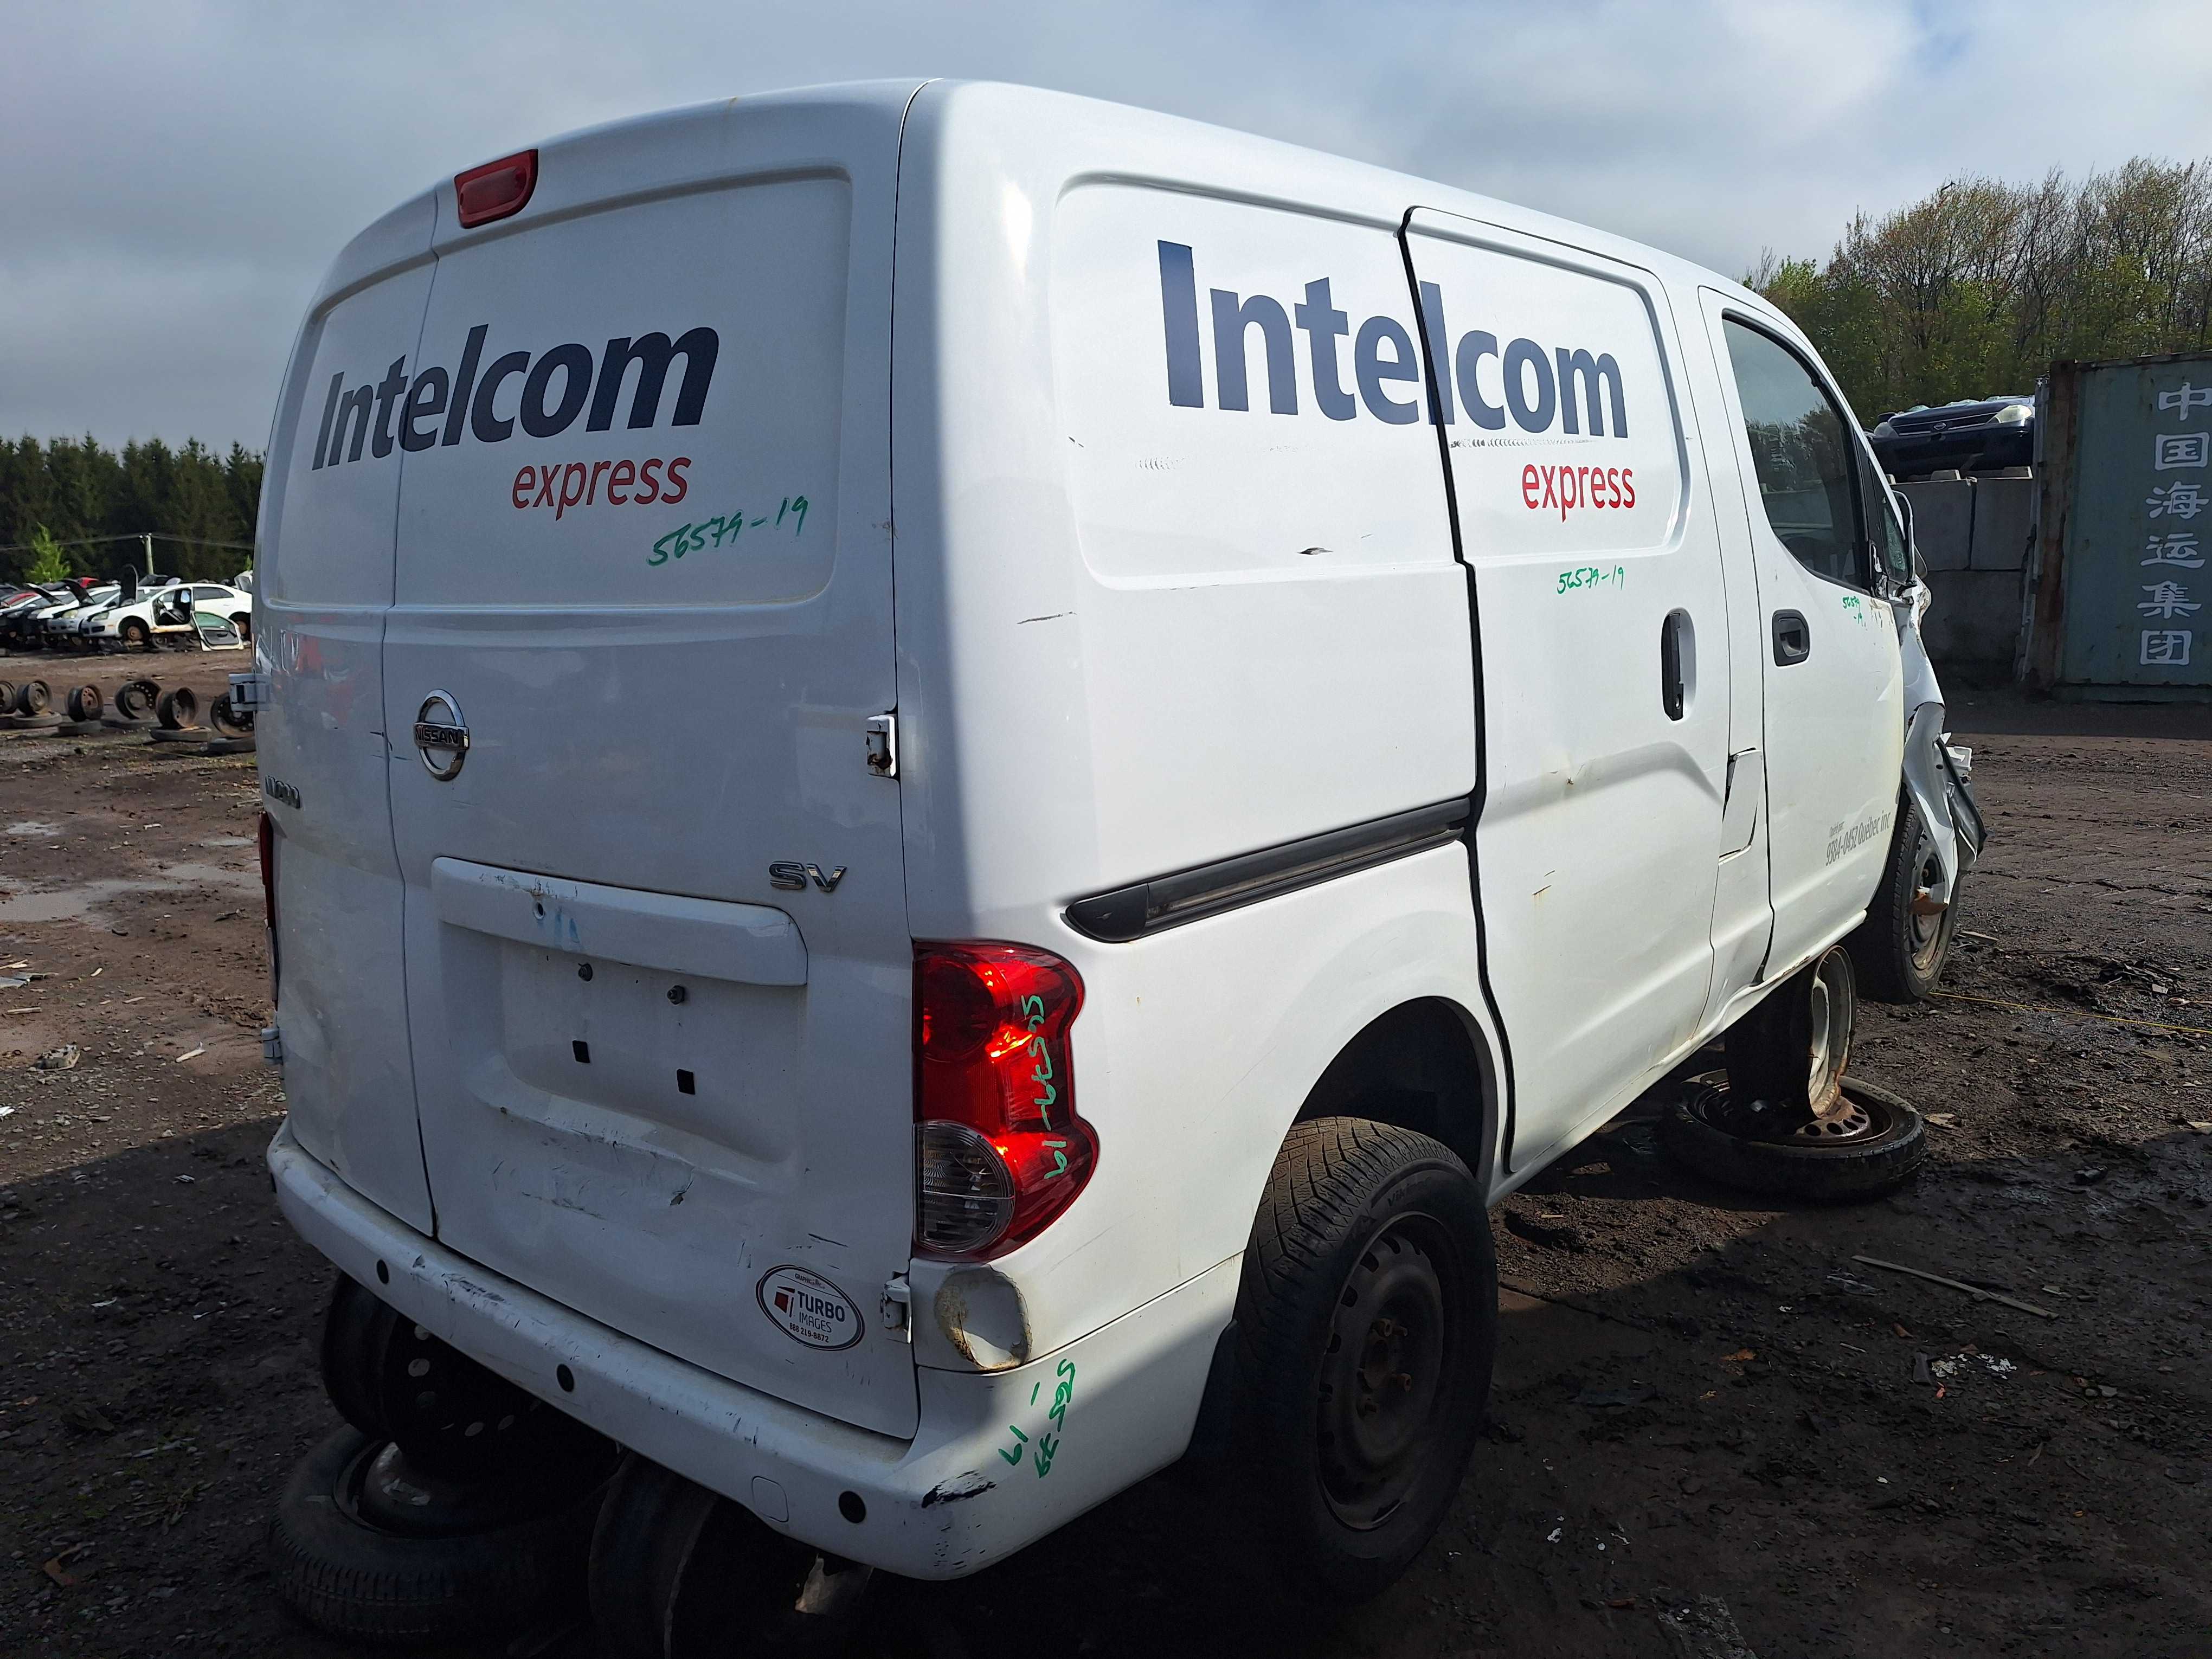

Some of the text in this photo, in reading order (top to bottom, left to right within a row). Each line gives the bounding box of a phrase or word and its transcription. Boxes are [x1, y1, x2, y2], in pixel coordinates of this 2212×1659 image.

[1157, 239, 1628, 438] Intelcom
[312, 324, 719, 471] Intelcom
[511, 457, 692, 520] express
[1522, 463, 1635, 523] express
[647, 495, 809, 566] 56579-19
[2136, 381, 2212, 667] 中国海运集团
[416, 725, 458, 745] NISSAN
[1825, 825, 1858, 866] 9384-0452
[1859, 816, 1880, 845] Québec
[769, 861, 847, 892] SV
[789, 1322, 829, 1343] 888 219-8872
[798, 1290, 845, 1322] TURBO
[799, 1311, 832, 1333] IMAGES
